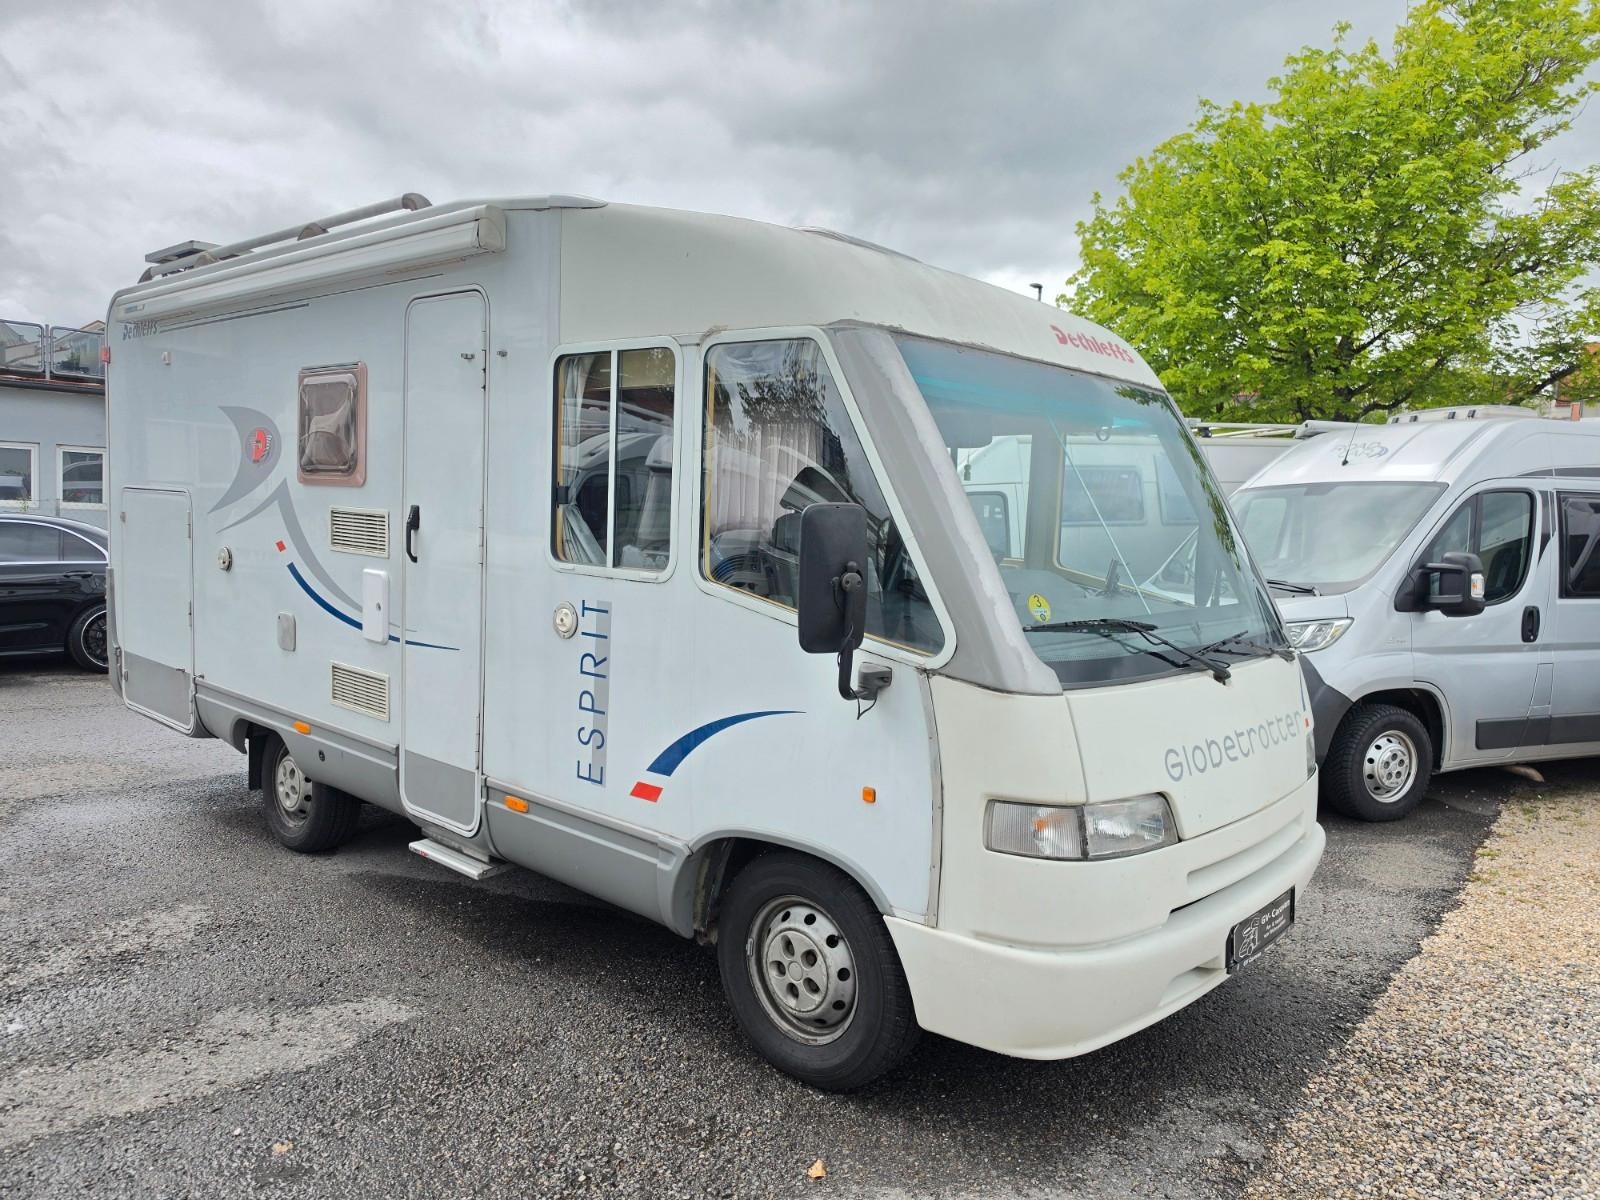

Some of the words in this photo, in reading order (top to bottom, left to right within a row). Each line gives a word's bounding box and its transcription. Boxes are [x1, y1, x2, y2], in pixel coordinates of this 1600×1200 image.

[1049, 323, 1136, 364] Dethleffs
[1033, 595, 1042, 608] 3
[576, 599, 609, 785] ESPRIT
[1164, 710, 1302, 782] Globetrotter
